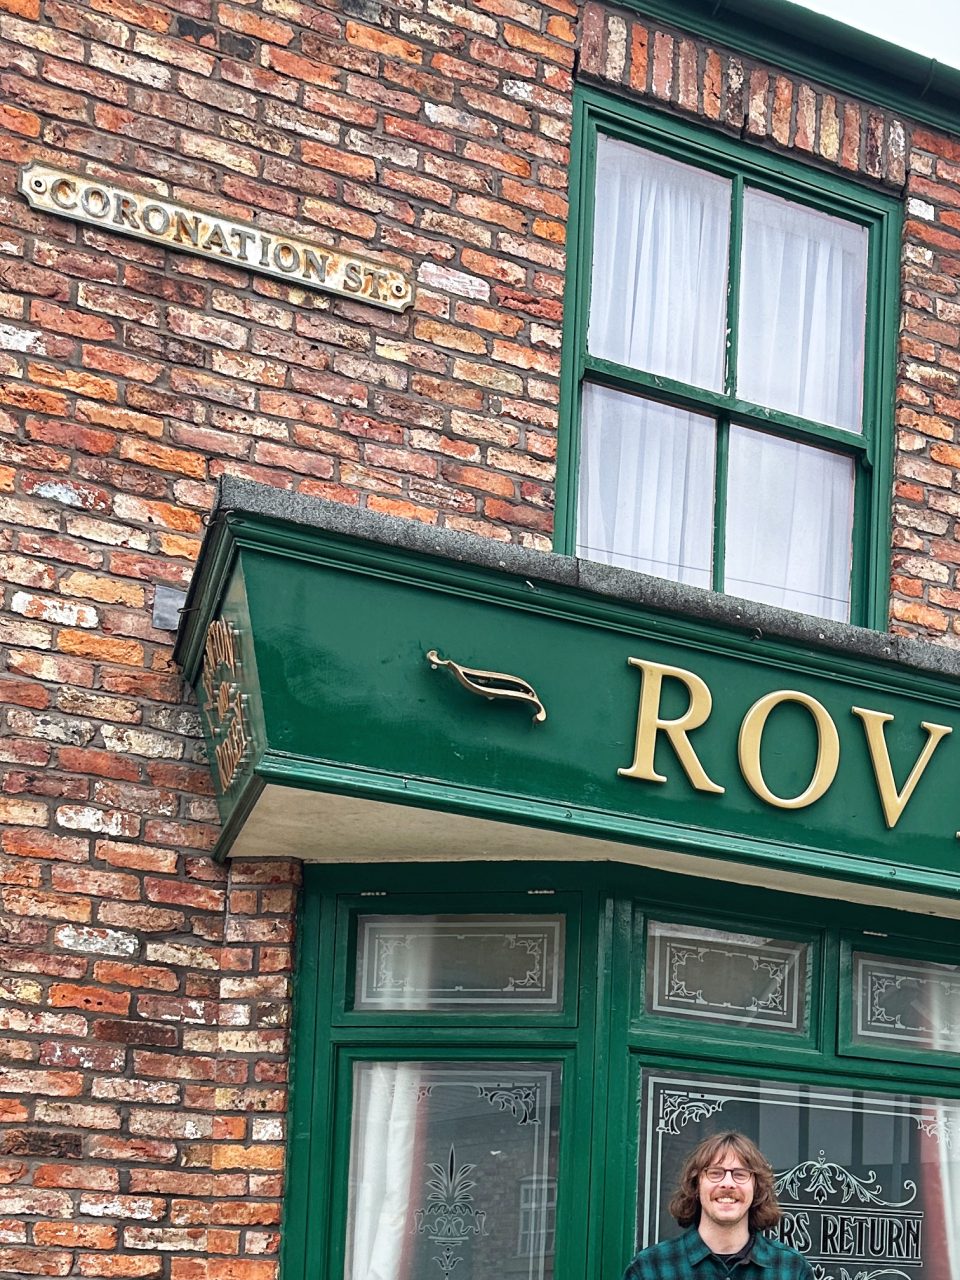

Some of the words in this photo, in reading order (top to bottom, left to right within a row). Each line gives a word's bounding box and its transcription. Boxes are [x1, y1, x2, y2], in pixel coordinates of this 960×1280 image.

[49, 177, 330, 284] CORONATION
[342, 262, 389, 301] ST.
[820, 1213, 922, 1259] RETURN
